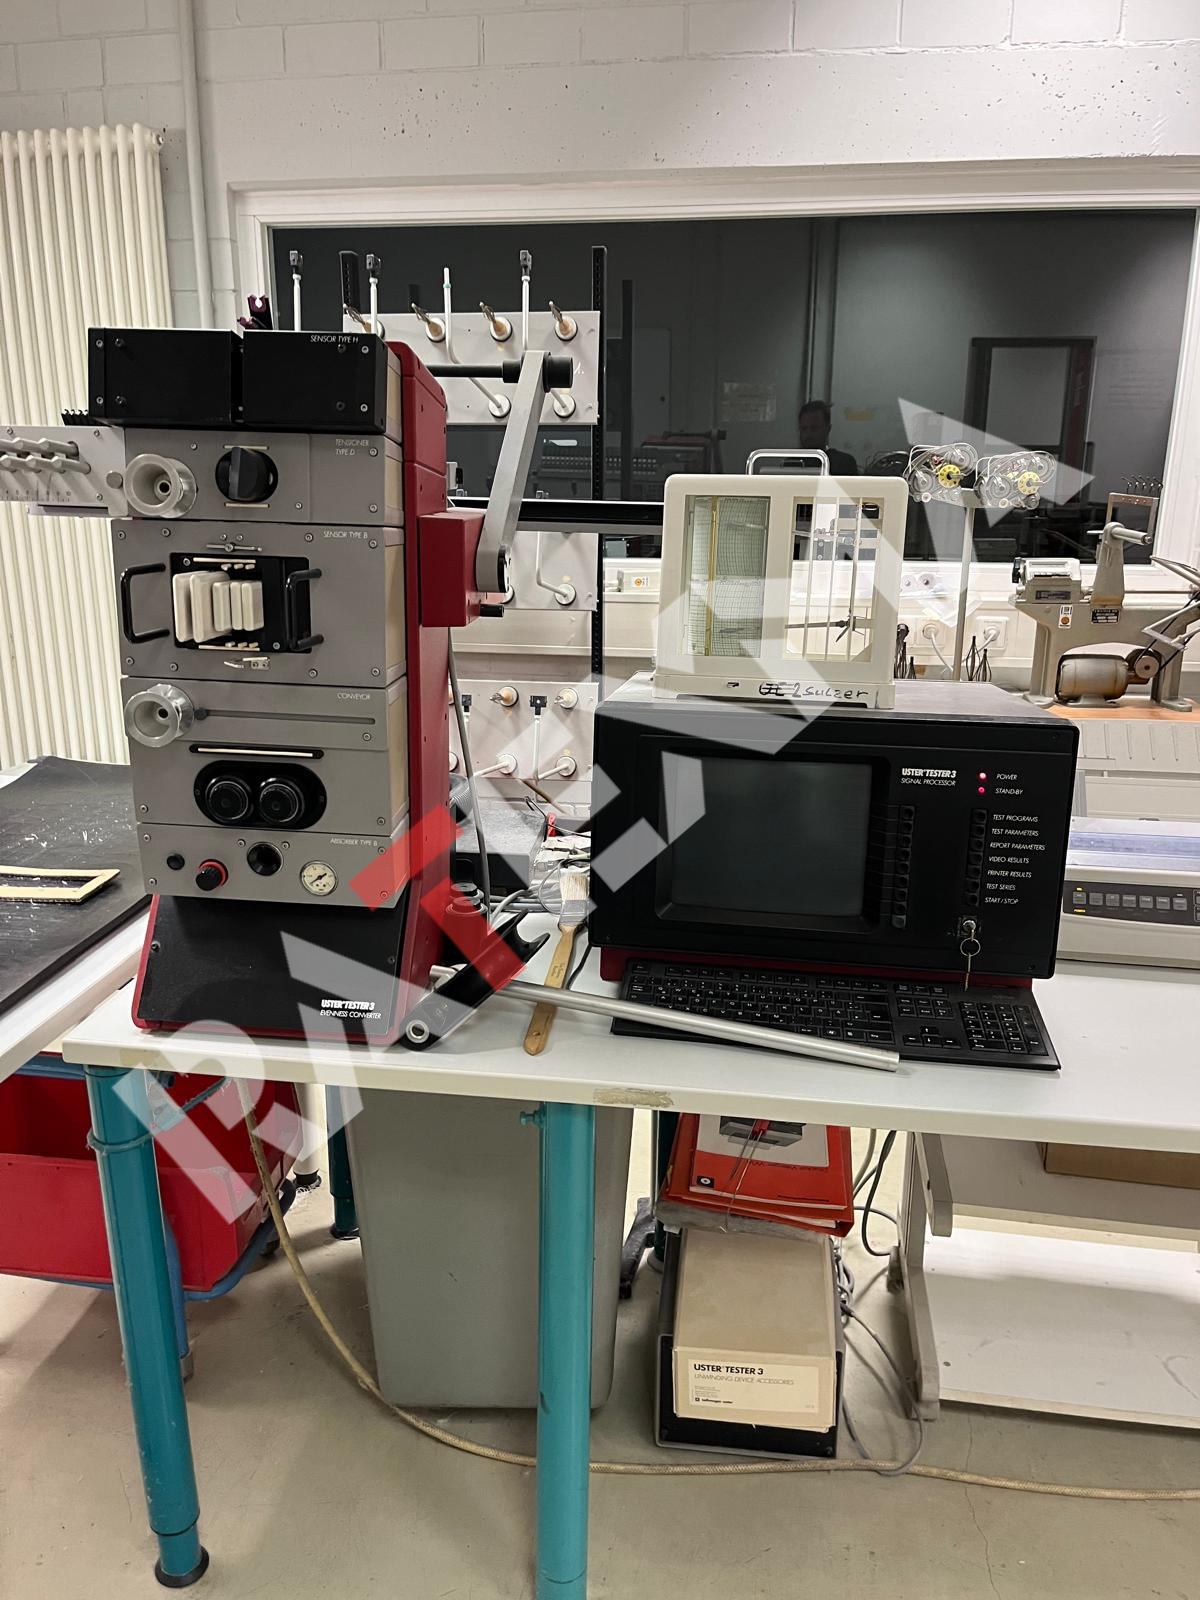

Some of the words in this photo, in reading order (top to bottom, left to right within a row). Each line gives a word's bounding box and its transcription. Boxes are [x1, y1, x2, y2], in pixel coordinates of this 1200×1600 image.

[310, 335, 336, 343] SENSOR
[335, 448, 348, 456] TYPE
[323, 530, 347, 538] SENSOR
[349, 531, 361, 539] TYPE
[901, 768, 924, 777] USTER
[925, 769, 951, 778] TESTER
[950, 770, 957, 779] 3
[996, 773, 1018, 781] POWER
[901, 777, 922, 785] SIGNAL
[923, 778, 957, 787] PROCESSOR
[1006, 814, 1039, 823] PROGRAMS
[1004, 829, 1039, 837] PARAMETERS
[1011, 843, 1046, 851] PARAMETERS
[1007, 856, 1030, 864] RESULTS
[987, 869, 1010, 877] PRINTER
[1010, 870, 1033, 879] RESULTS
[999, 883, 1017, 891] SERIES
[321, 999, 343, 1009] USTER
[344, 1000, 369, 1010] TESTER
[369, 1002, 376, 1011] 3
[320, 1009, 349, 1018] EVENNESS
[349, 1011, 382, 1020] CONVERTER
[693, 1363, 722, 1373] USTER
[725, 1365, 756, 1375] TESTER
[757, 1367, 764, 1375] 3
